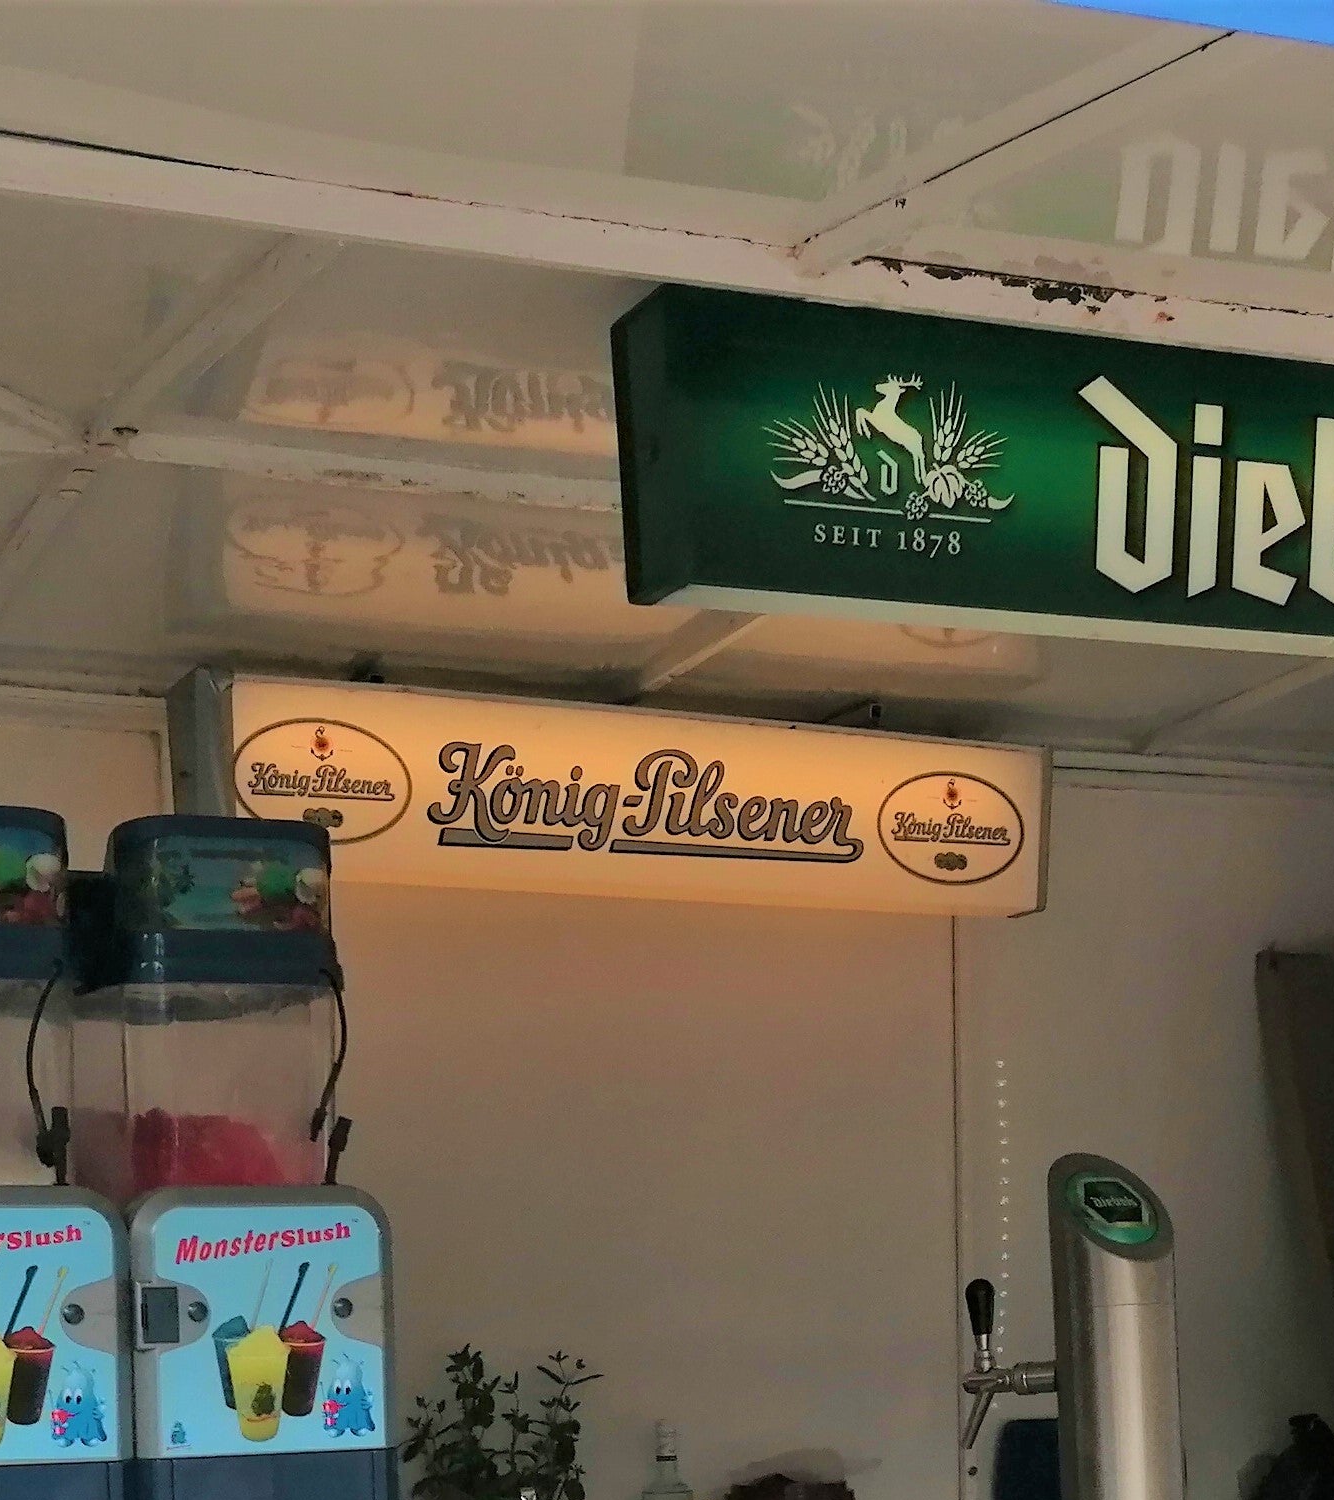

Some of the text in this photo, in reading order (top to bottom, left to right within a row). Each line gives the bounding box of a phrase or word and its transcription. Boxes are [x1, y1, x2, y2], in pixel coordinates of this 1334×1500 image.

[813, 523, 961, 558] SEIT 1878
[427, 742, 864, 862] König-Pilsener
[175, 1222, 351, 1265] MonsterSlush
